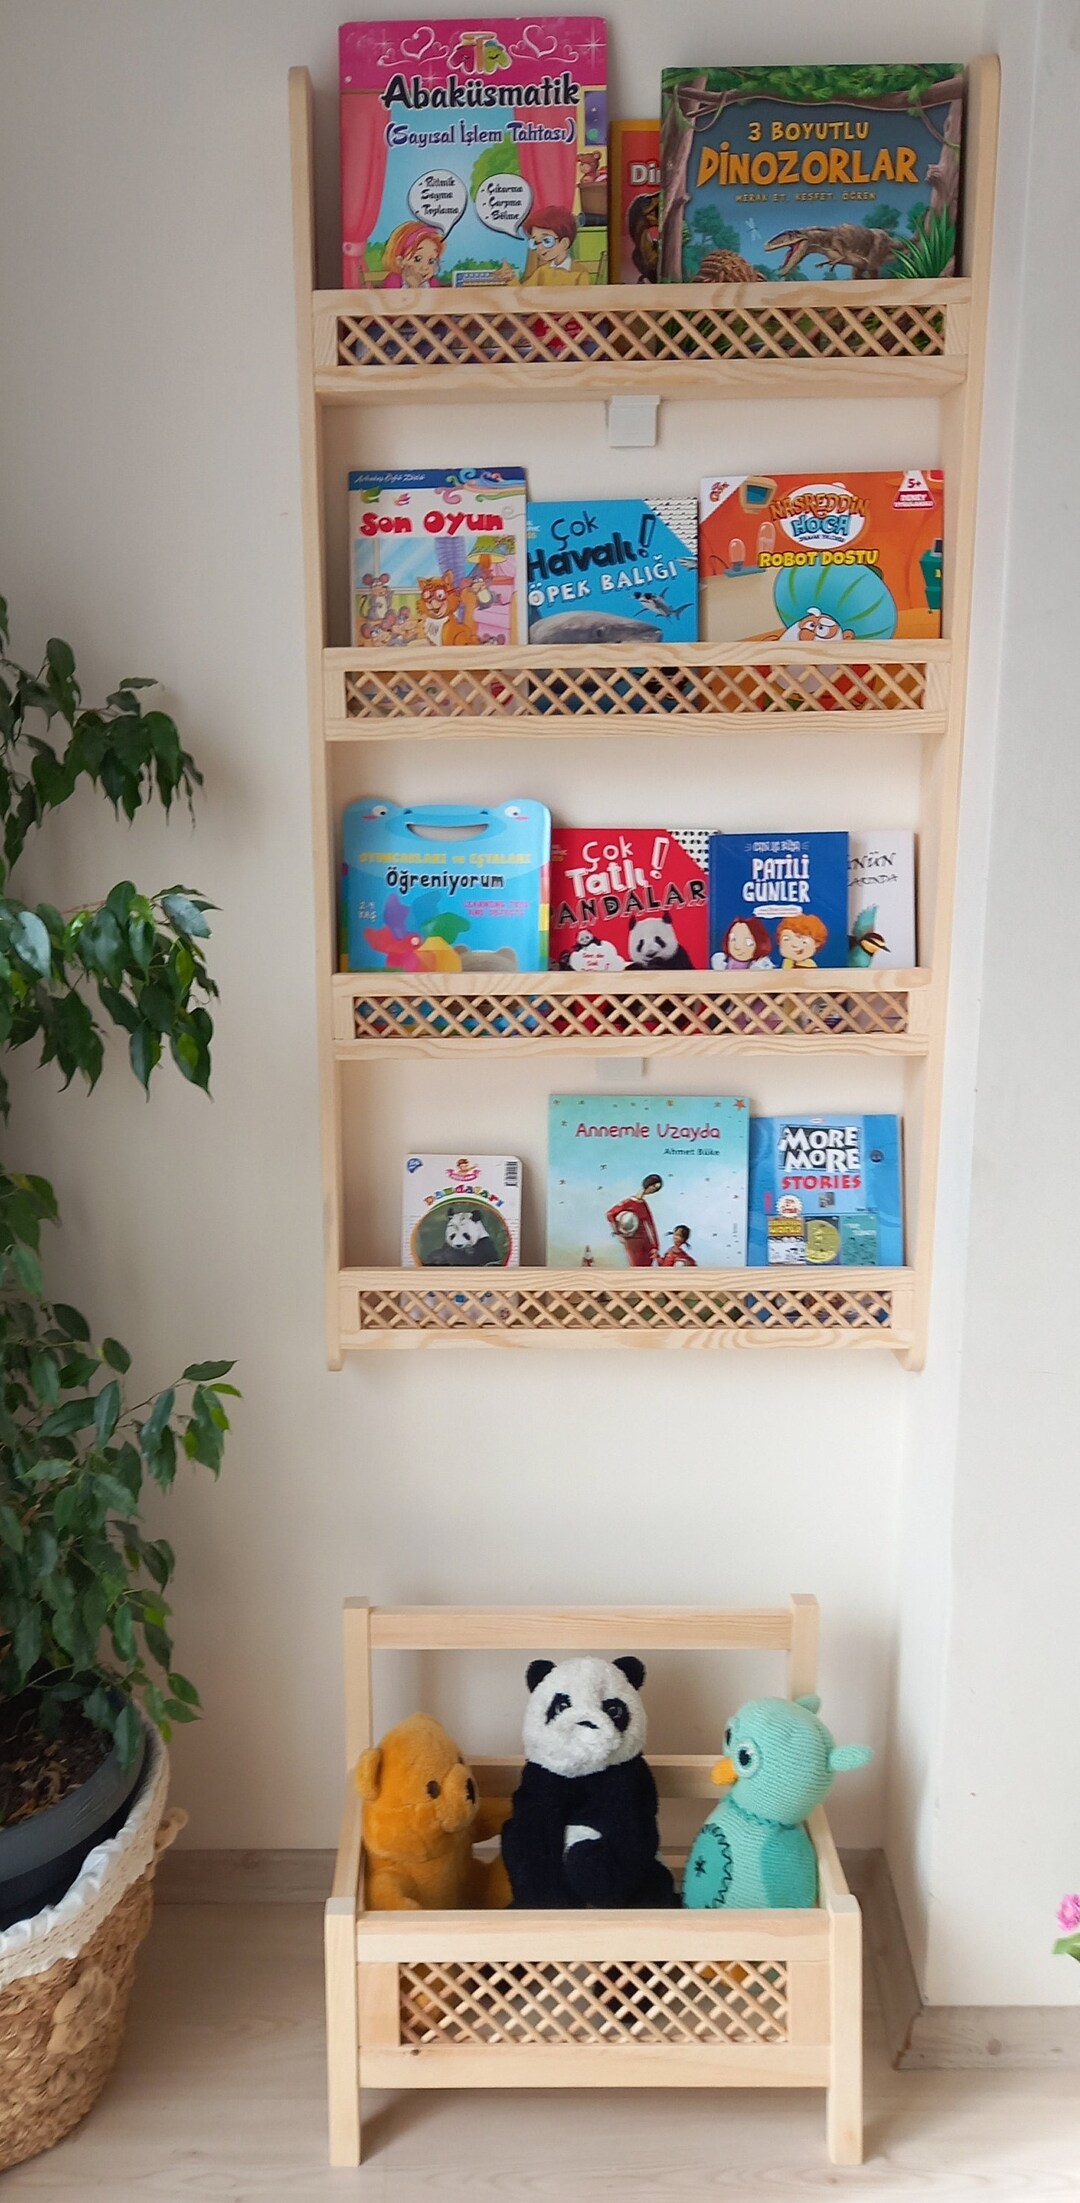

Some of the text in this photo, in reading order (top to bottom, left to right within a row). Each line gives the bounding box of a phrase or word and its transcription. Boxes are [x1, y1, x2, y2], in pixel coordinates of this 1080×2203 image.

[381, 72, 580, 109] Abaküsmatik
[386, 117, 577, 147] (Sayısal İşlem Tahtası)
[748, 121, 869, 142] 3 BOYUTLU
[696, 141, 918, 187] DİNOZORLAR
[907, 478, 922, 488] 5+
[769, 493, 870, 520] NASREDDİN
[360, 512, 412, 536] Son
[423, 511, 503, 536] Oyun
[551, 511, 599, 550] Çok
[791, 515, 850, 537] HOCA
[758, 550, 879, 567] ROBOT DOSTU
[601, 554, 698, 592] BALIĞI
[582, 836, 634, 873] Çok
[752, 854, 810, 880] PATİLİ
[386, 867, 505, 895] Öğreniyorum
[742, 879, 811, 903] GÜNLER
[551, 879, 707, 928] ANDALAR
[575, 1122, 721, 1142] Annemle Uzayda
[778, 1126, 858, 1151] MORE
[664, 1148, 695, 1156] Ahmet
[784, 1148, 861, 1173] MORE
[782, 1175, 862, 1189] STORIES
